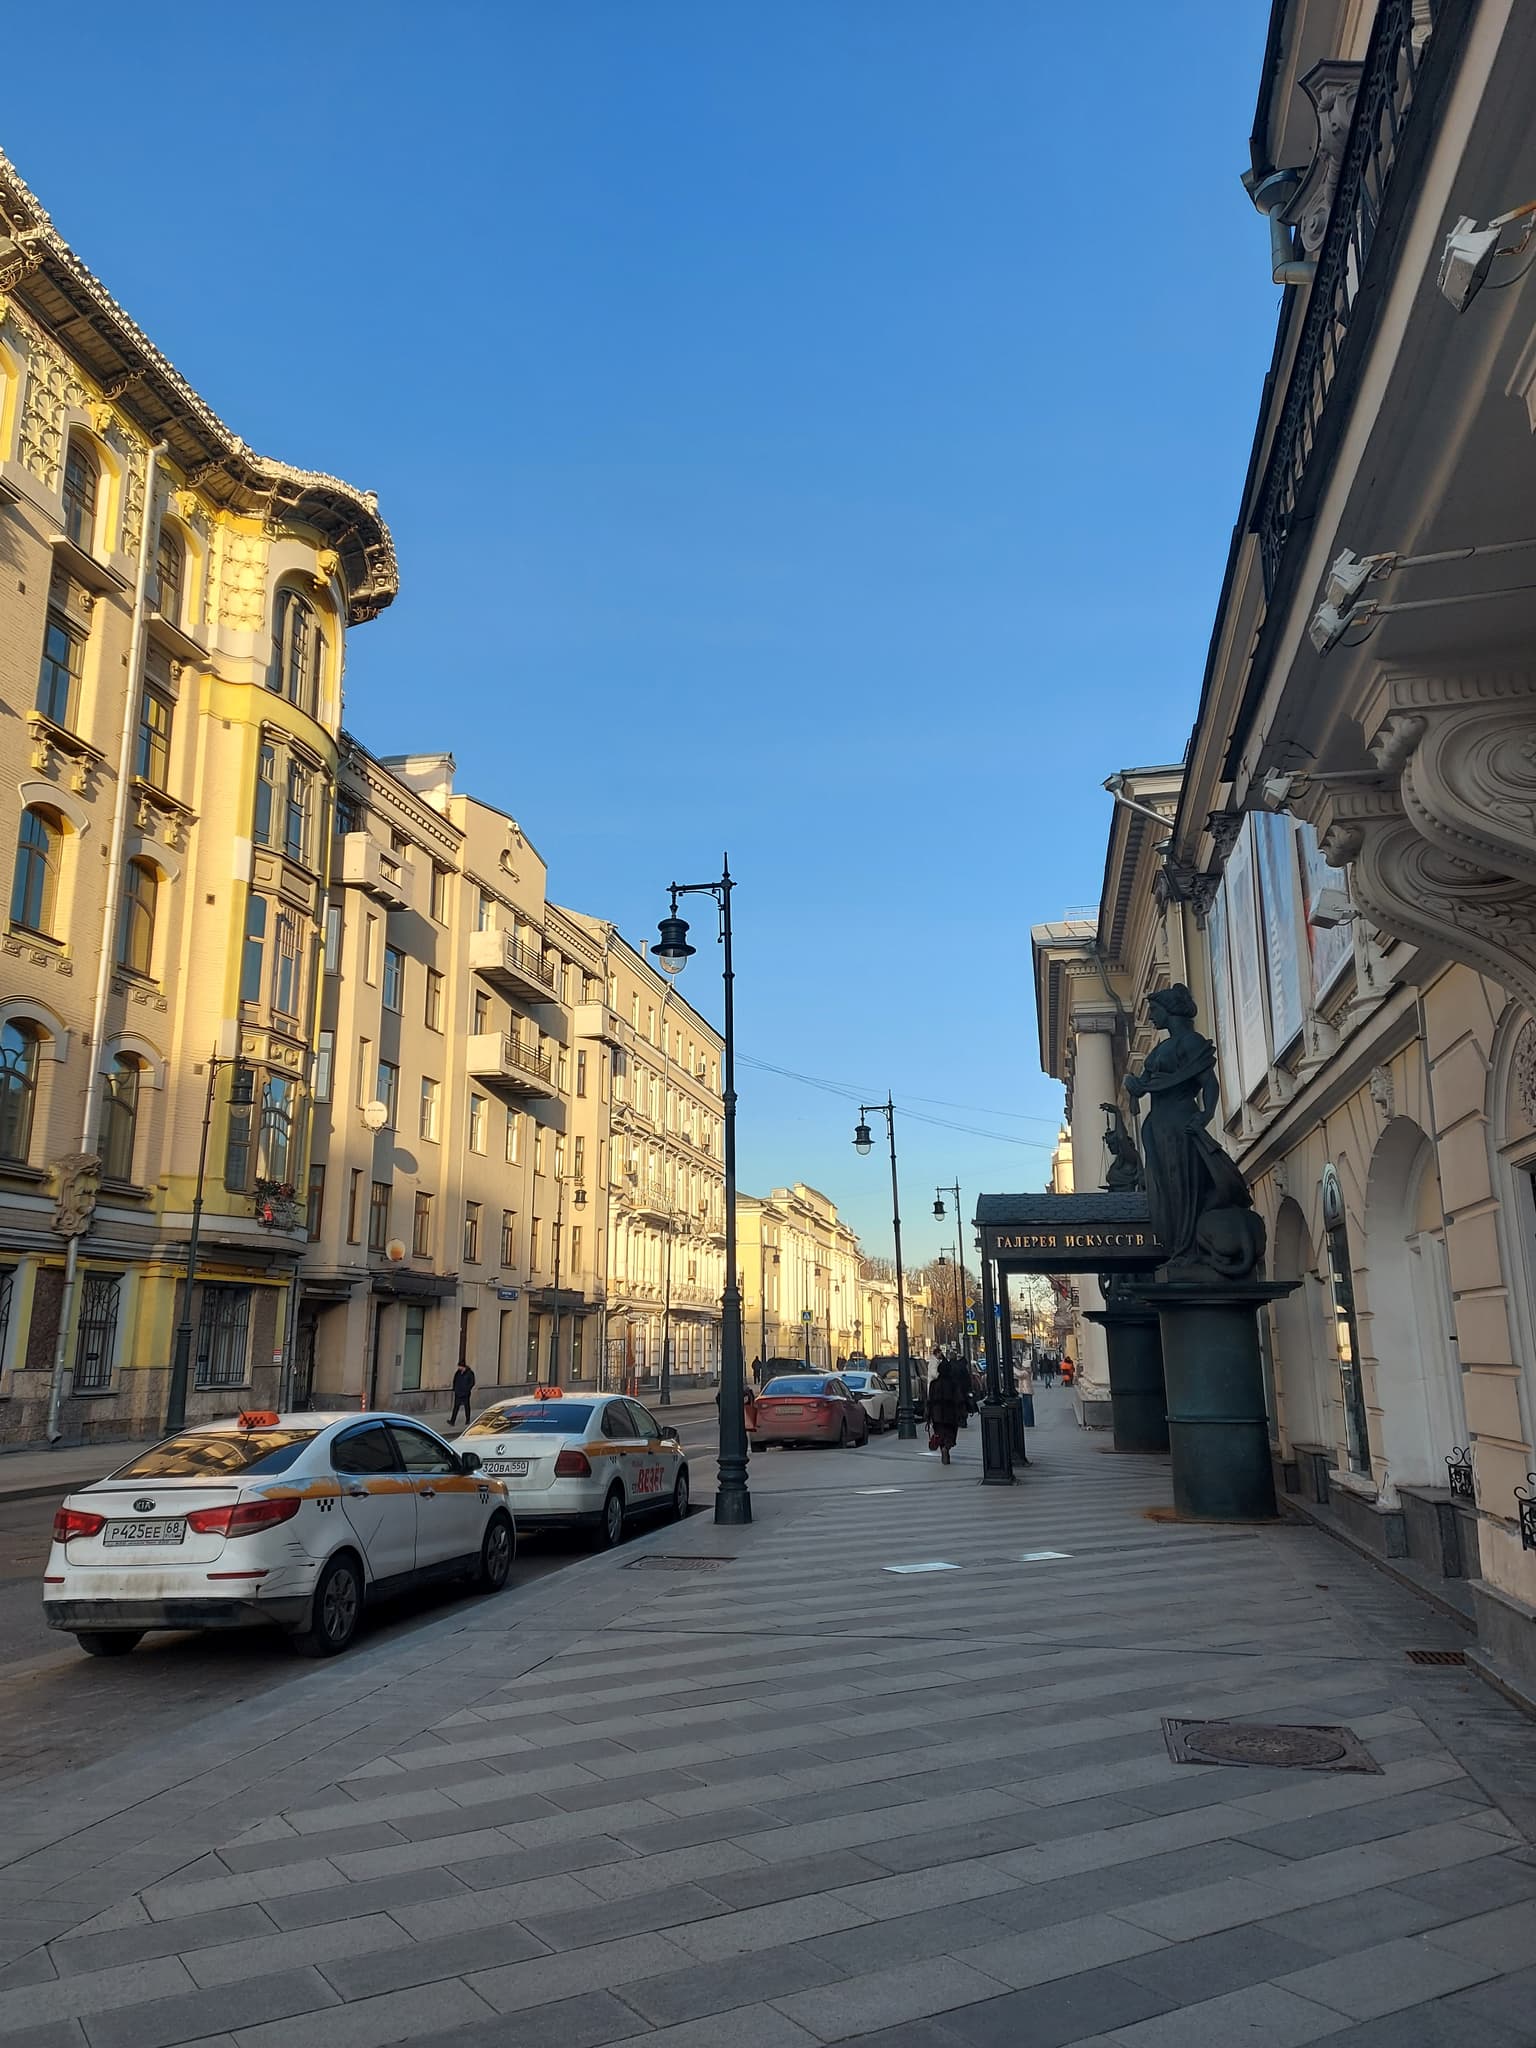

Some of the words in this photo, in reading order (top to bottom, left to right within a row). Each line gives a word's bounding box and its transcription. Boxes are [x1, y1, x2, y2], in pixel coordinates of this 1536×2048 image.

[997, 1236, 1056, 1248] ГАЛЕРЕЯ
[1065, 1234, 1144, 1247] ИСКУССТВ
[482, 1463, 510, 1473] 320ВА
[511, 1462, 526, 1470] 550
[135, 1501, 151, 1510] KIA
[112, 1524, 161, 1539] Р425ЕЕ
[166, 1522, 180, 1533] 68
